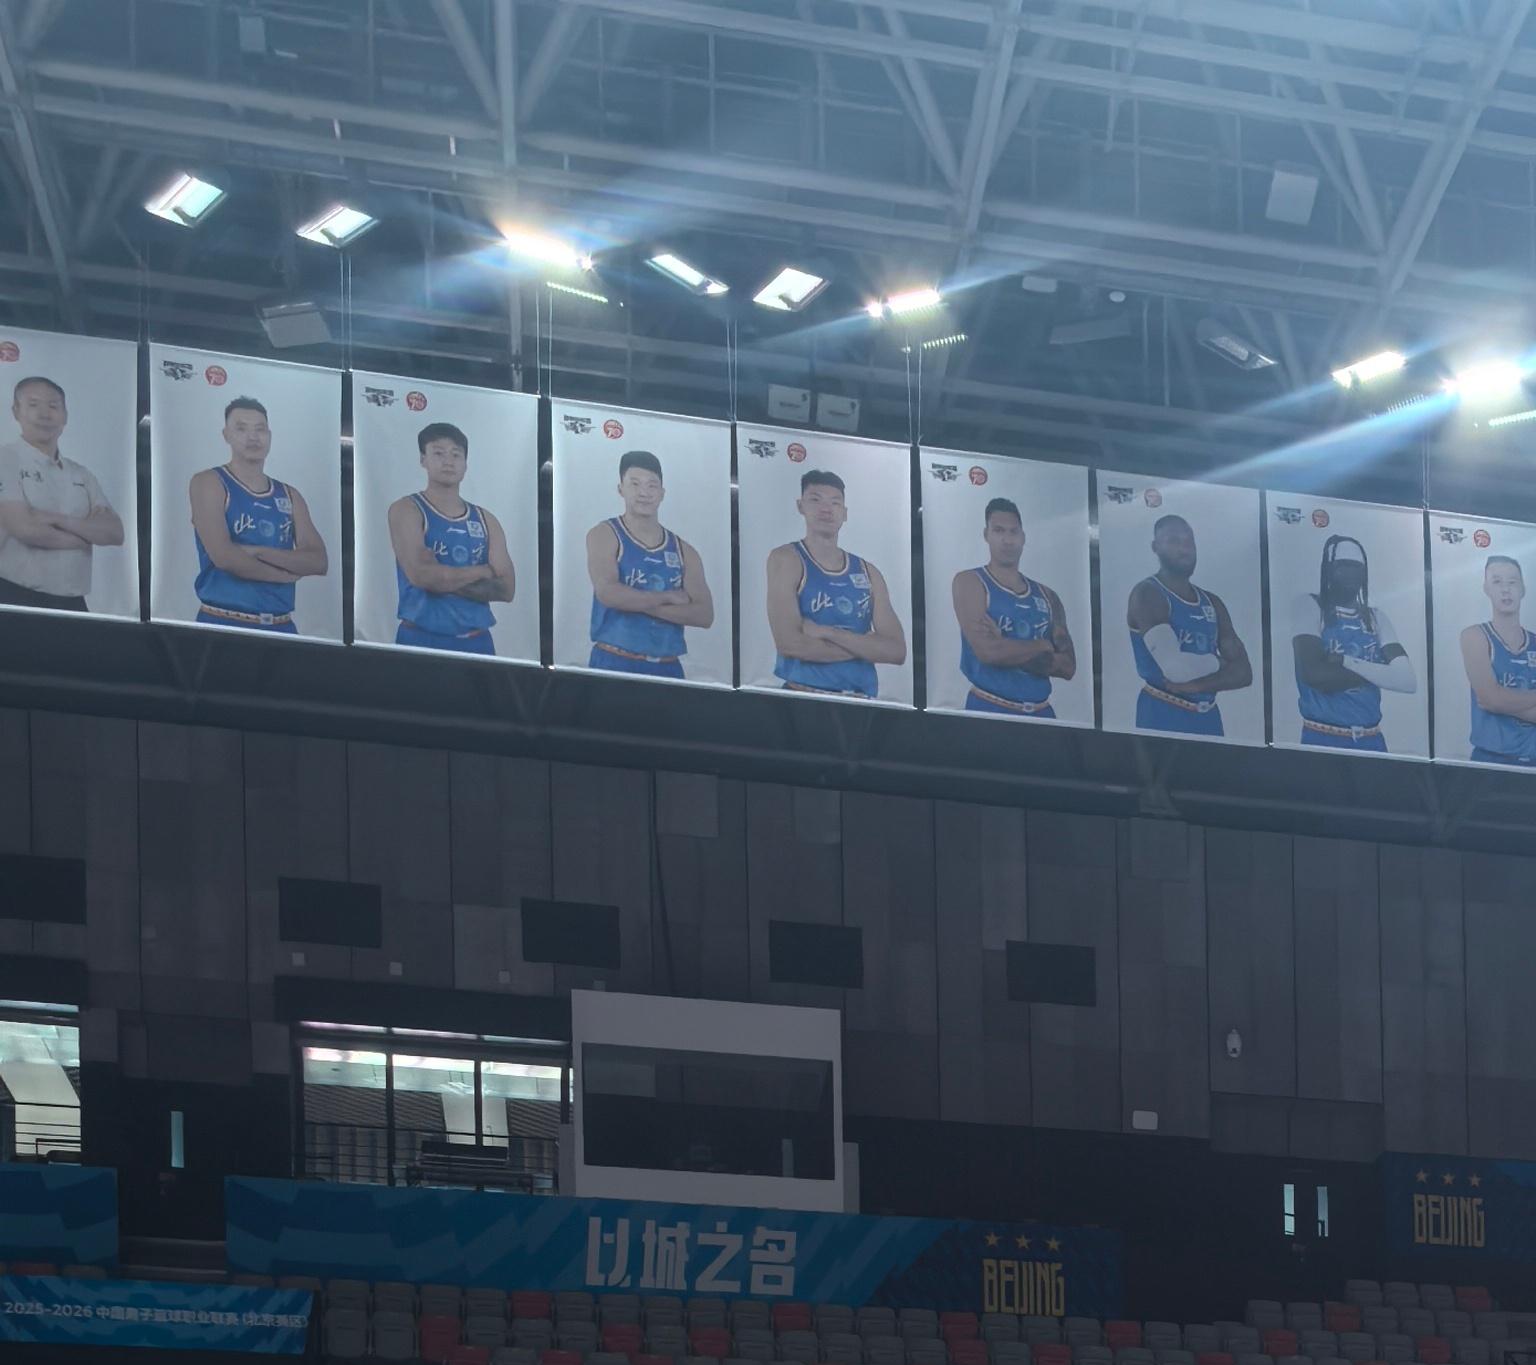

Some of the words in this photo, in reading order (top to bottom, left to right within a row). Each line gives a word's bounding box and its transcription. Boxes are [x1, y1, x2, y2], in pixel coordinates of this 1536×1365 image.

[1412, 1193, 1486, 1248] BEIJING
[585, 1215, 797, 1297] 以城之名
[5, 1302, 93, 1319] 2025-2026
[982, 1258, 1066, 1318] BEIJING
